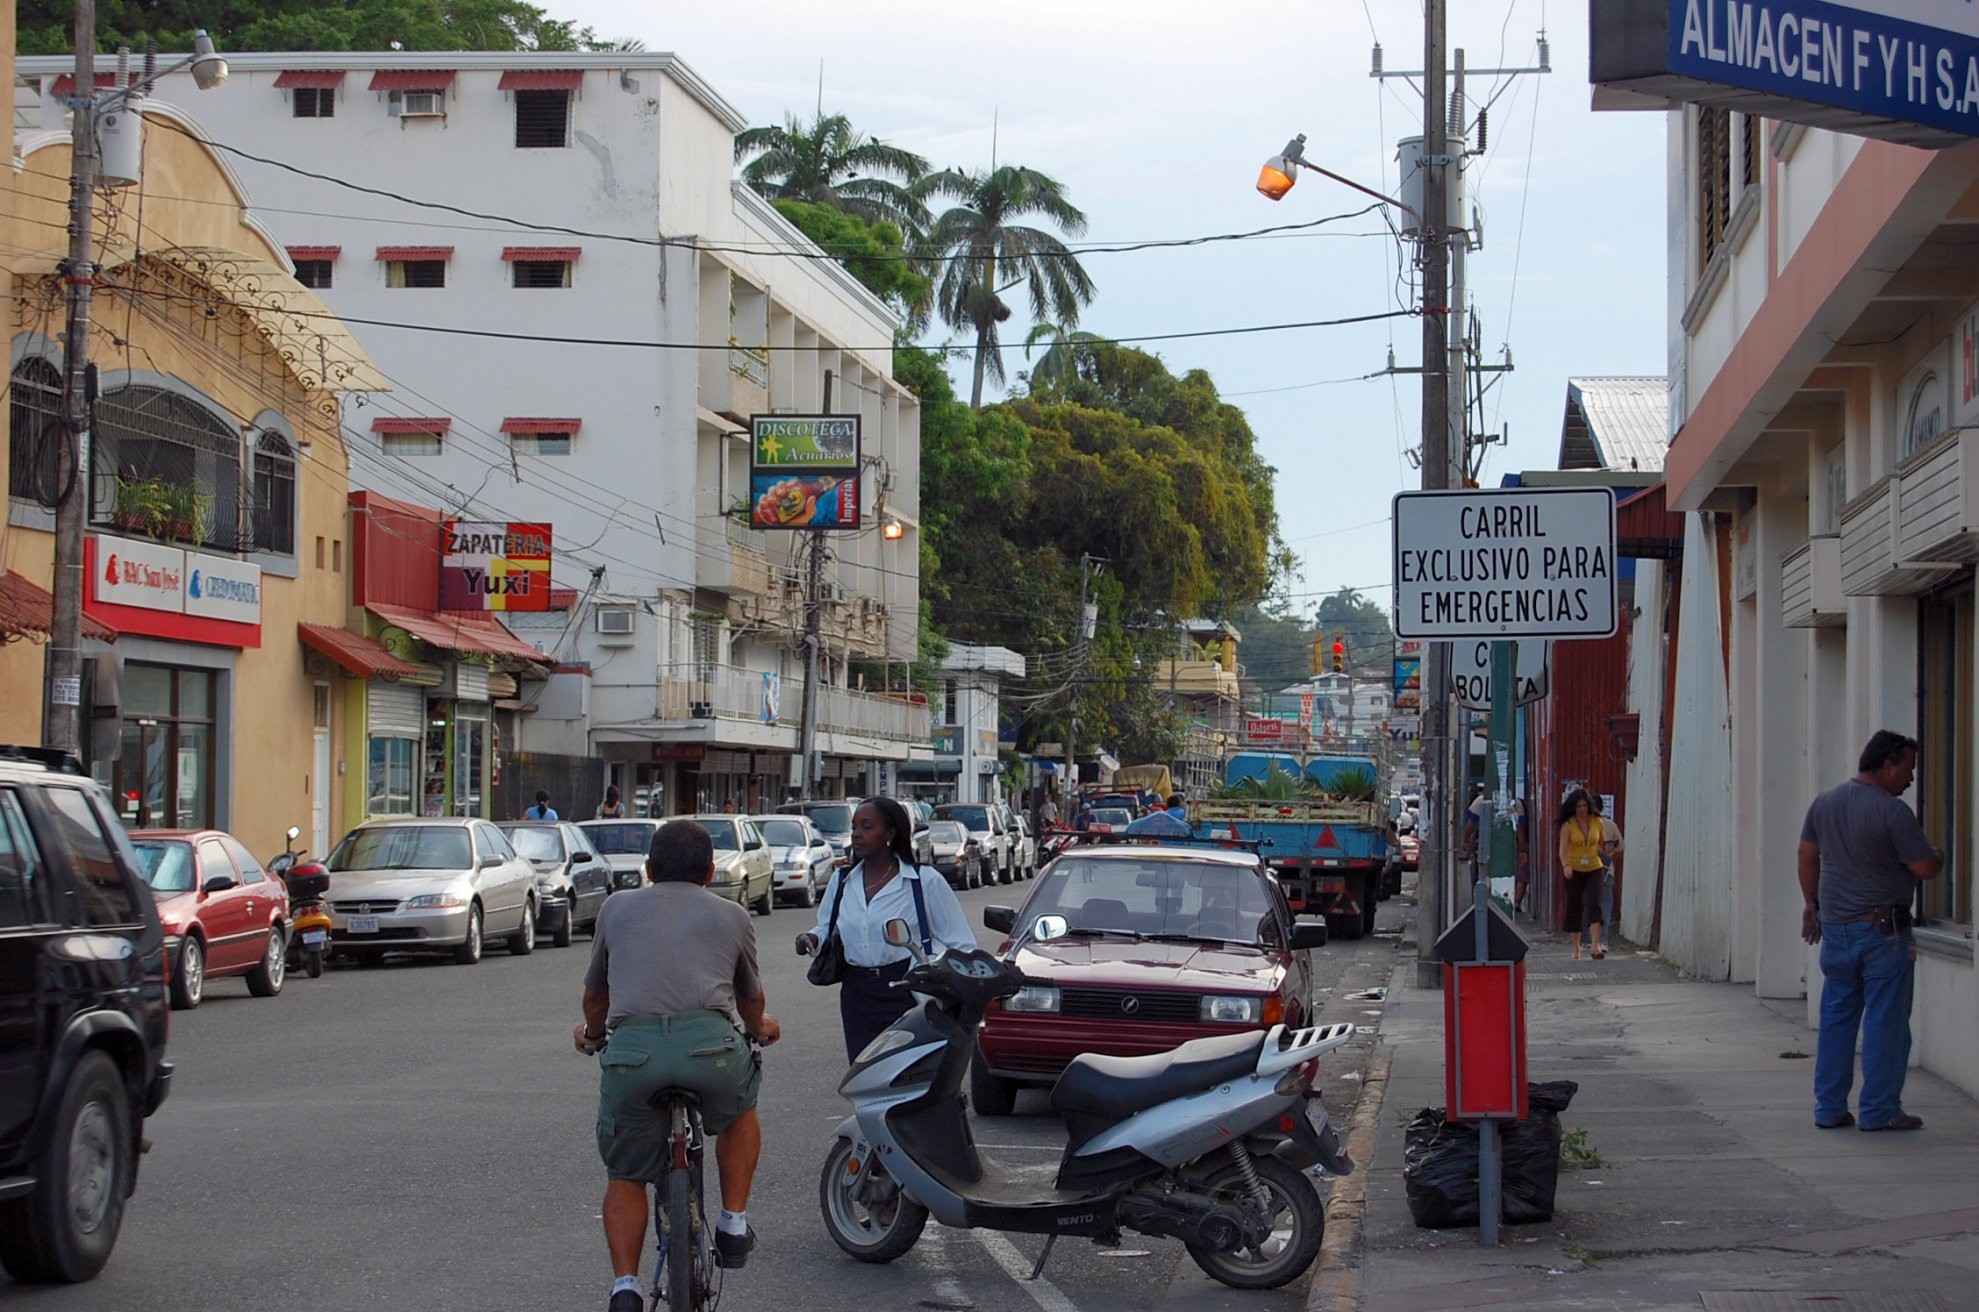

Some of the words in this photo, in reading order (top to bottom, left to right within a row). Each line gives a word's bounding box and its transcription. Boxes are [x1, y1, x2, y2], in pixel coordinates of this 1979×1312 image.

[1680, 0, 1842, 88] ALMACEN
[1853, 29, 1870, 91] F
[1877, 34, 1899, 98] Y
[1907, 41, 1926, 105] H
[759, 422, 852, 436] DISCOTECA
[786, 447, 849, 460] Acuarios
[840, 479, 856, 523] Imperial
[1460, 505, 1546, 539] CARRIL
[447, 534, 545, 554] ZAPATERIA
[1401, 547, 1530, 582] EXCLUSIVO
[1543, 546, 1607, 579] PARA
[463, 569, 530, 595] Yuxi
[1421, 588, 1588, 623] EMERGENCIAS
[1456, 675, 1538, 702] BOLTA
[1057, 1214, 1094, 1225] VENTO
